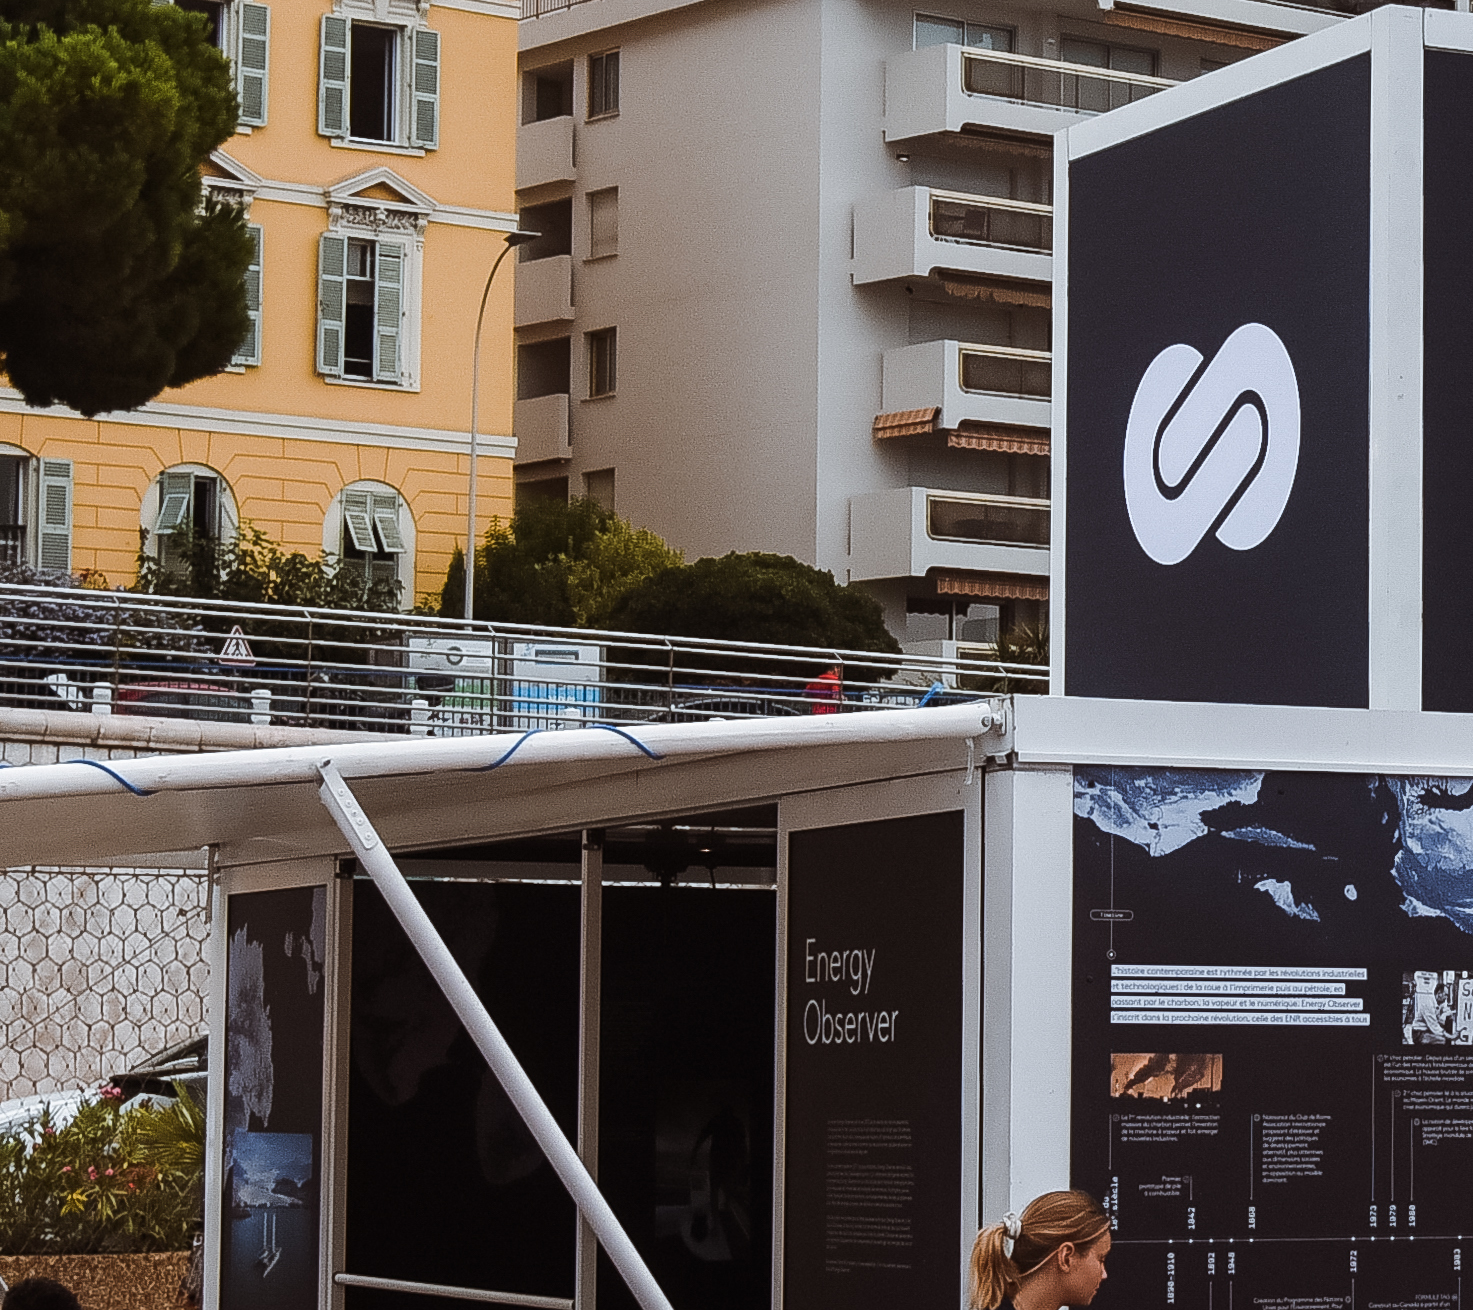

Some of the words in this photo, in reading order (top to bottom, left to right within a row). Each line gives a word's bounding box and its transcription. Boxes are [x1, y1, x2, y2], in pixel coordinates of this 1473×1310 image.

[806, 939, 875, 995] Energy
[1206, 968, 1218, 976] est
[1254, 971, 1266, 979] par
[1269, 969, 1279, 977] les
[1280, 969, 1321, 978] révolutions
[1322, 970, 1365, 978] industrielles
[1183, 983, 1193, 991] de
[1194, 983, 1202, 991] la
[1143, 1000, 1156, 1008] par
[1158, 998, 1165, 1006] le
[1202, 999, 1210, 1007] la
[1211, 1001, 1237, 1009] vapeur
[1239, 999, 1247, 1007] et
[1301, 1000, 1326, 1010] Energy
[1327, 1000, 1361, 1008] Observer
[804, 999, 899, 1045] Observer
[1141, 1013, 1160, 1022] dans
[1162, 1014, 1169, 1022] la
[1171, 1014, 1209, 1024] prochaine
[1270, 1015, 1283, 1023] des
[1369, 1205, 1377, 1227] 1973
[1389, 1204, 1397, 1227] 1979
